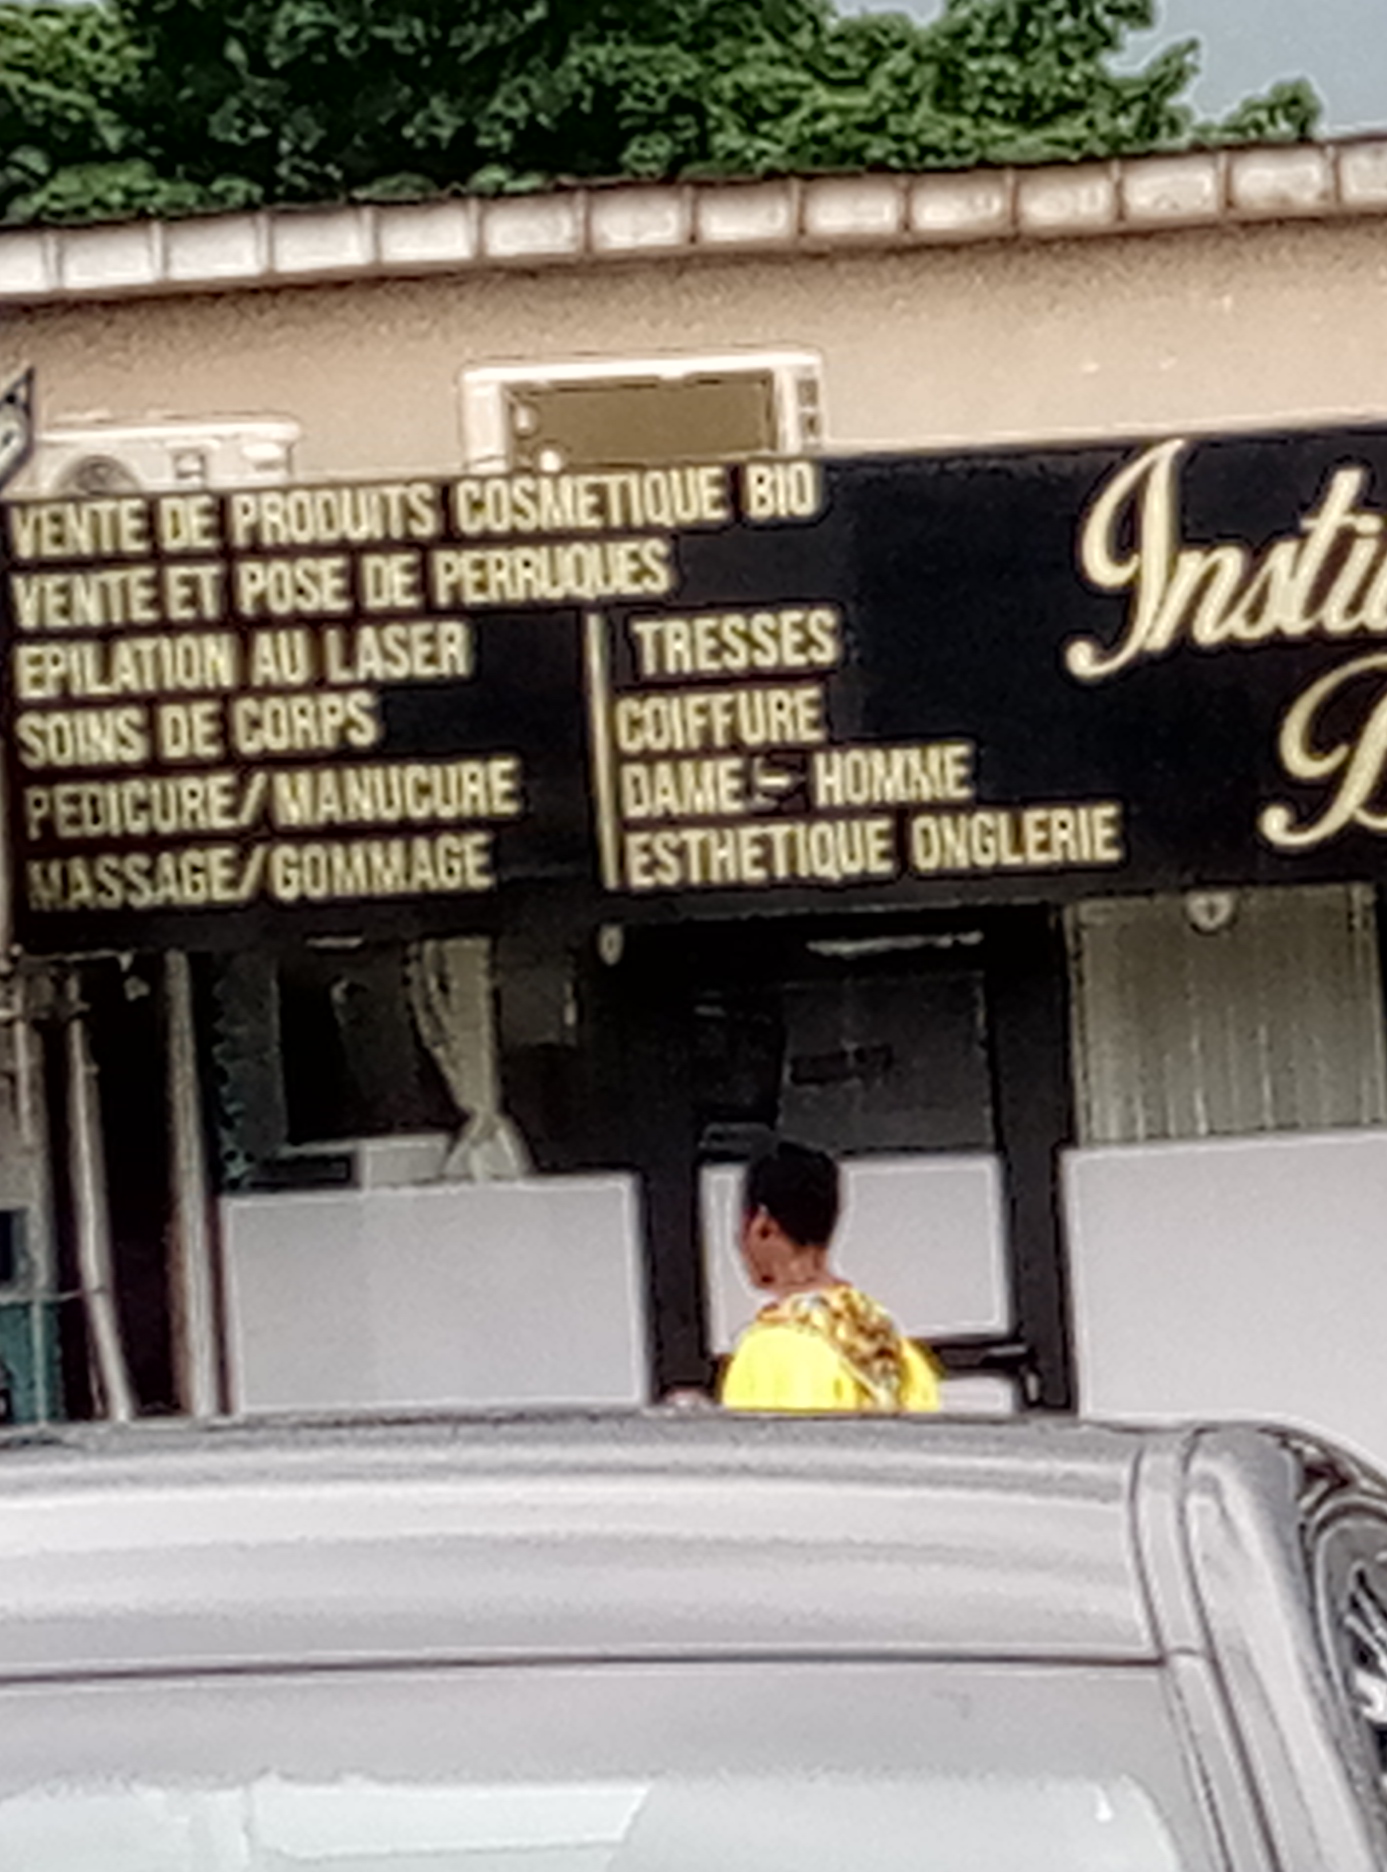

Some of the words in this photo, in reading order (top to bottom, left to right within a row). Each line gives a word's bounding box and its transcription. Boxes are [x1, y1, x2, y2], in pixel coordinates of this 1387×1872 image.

[10, 496, 148, 560] VENTE
[158, 495, 219, 550] DE
[230, 481, 439, 546] PRODUITS
[454, 465, 729, 535] COSMETIQUE
[744, 461, 820, 521] BIO
[11, 566, 157, 630] VENTE
[166, 562, 225, 622] ET
[236, 556, 351, 617] POSE
[360, 552, 426, 610] DE
[434, 539, 672, 606] PERRUQUES
[14, 633, 236, 700] EPILATION
[251, 628, 306, 687] AU
[324, 619, 473, 683] LASER
[631, 609, 841, 677] TRESSES
[14, 705, 151, 769] SOINS
[159, 703, 226, 760] DE
[232, 692, 381, 755] CORPS
[615, 686, 828, 754] COIFFURE
[620, 757, 744, 818] DAME
[812, 743, 974, 808] HOMME
[623, 817, 897, 889] ESTHETIQUE
[910, 803, 1125, 874] ONGLERIE
